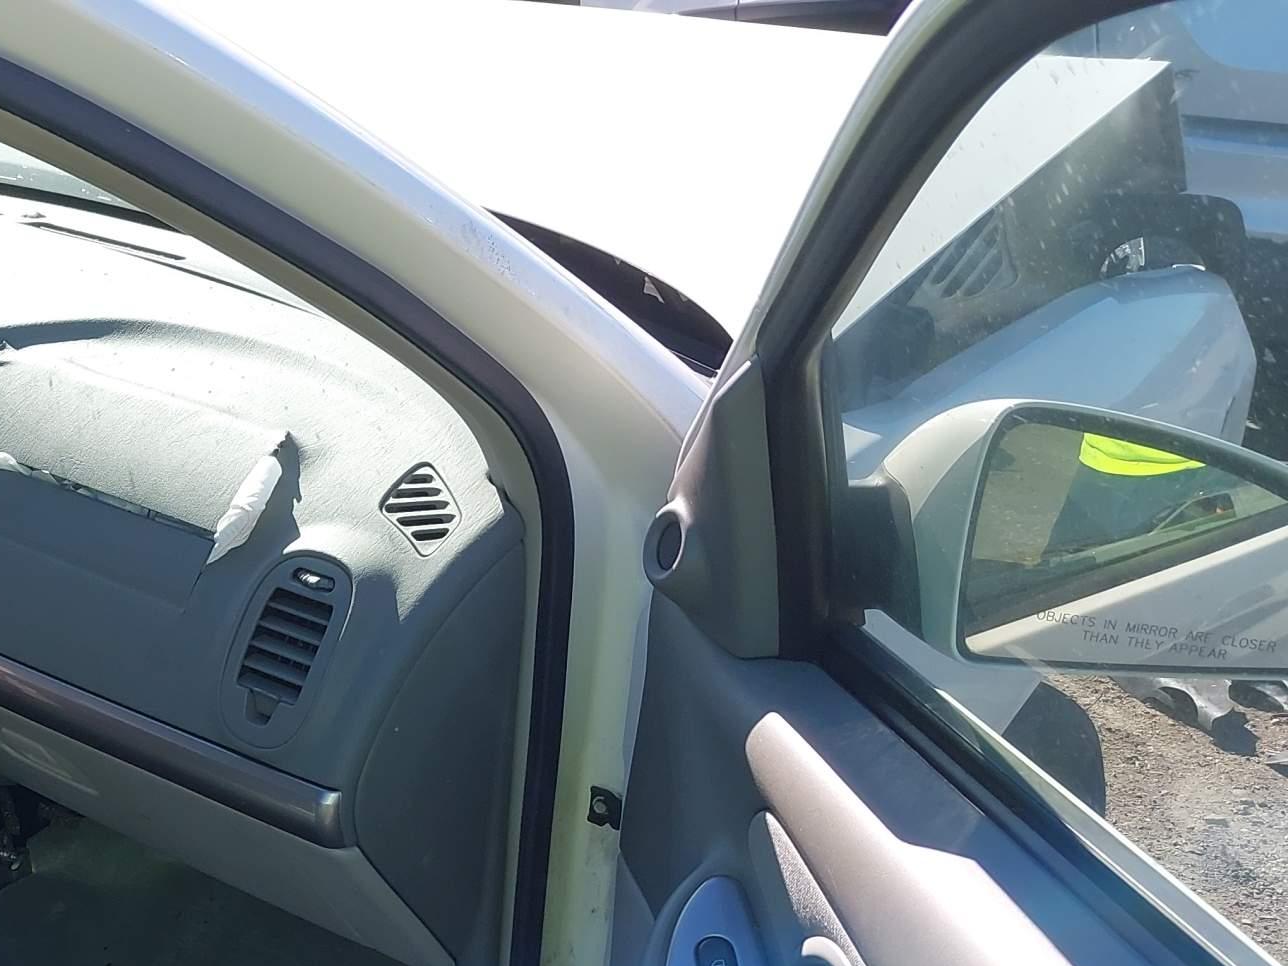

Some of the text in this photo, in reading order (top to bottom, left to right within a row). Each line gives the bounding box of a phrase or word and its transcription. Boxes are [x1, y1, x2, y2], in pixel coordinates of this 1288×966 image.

[1036, 610, 1277, 654] OBJECTS IN MIRROR ARE CLOSER
[1081, 630, 1228, 661] THAN THEY APPEAR
